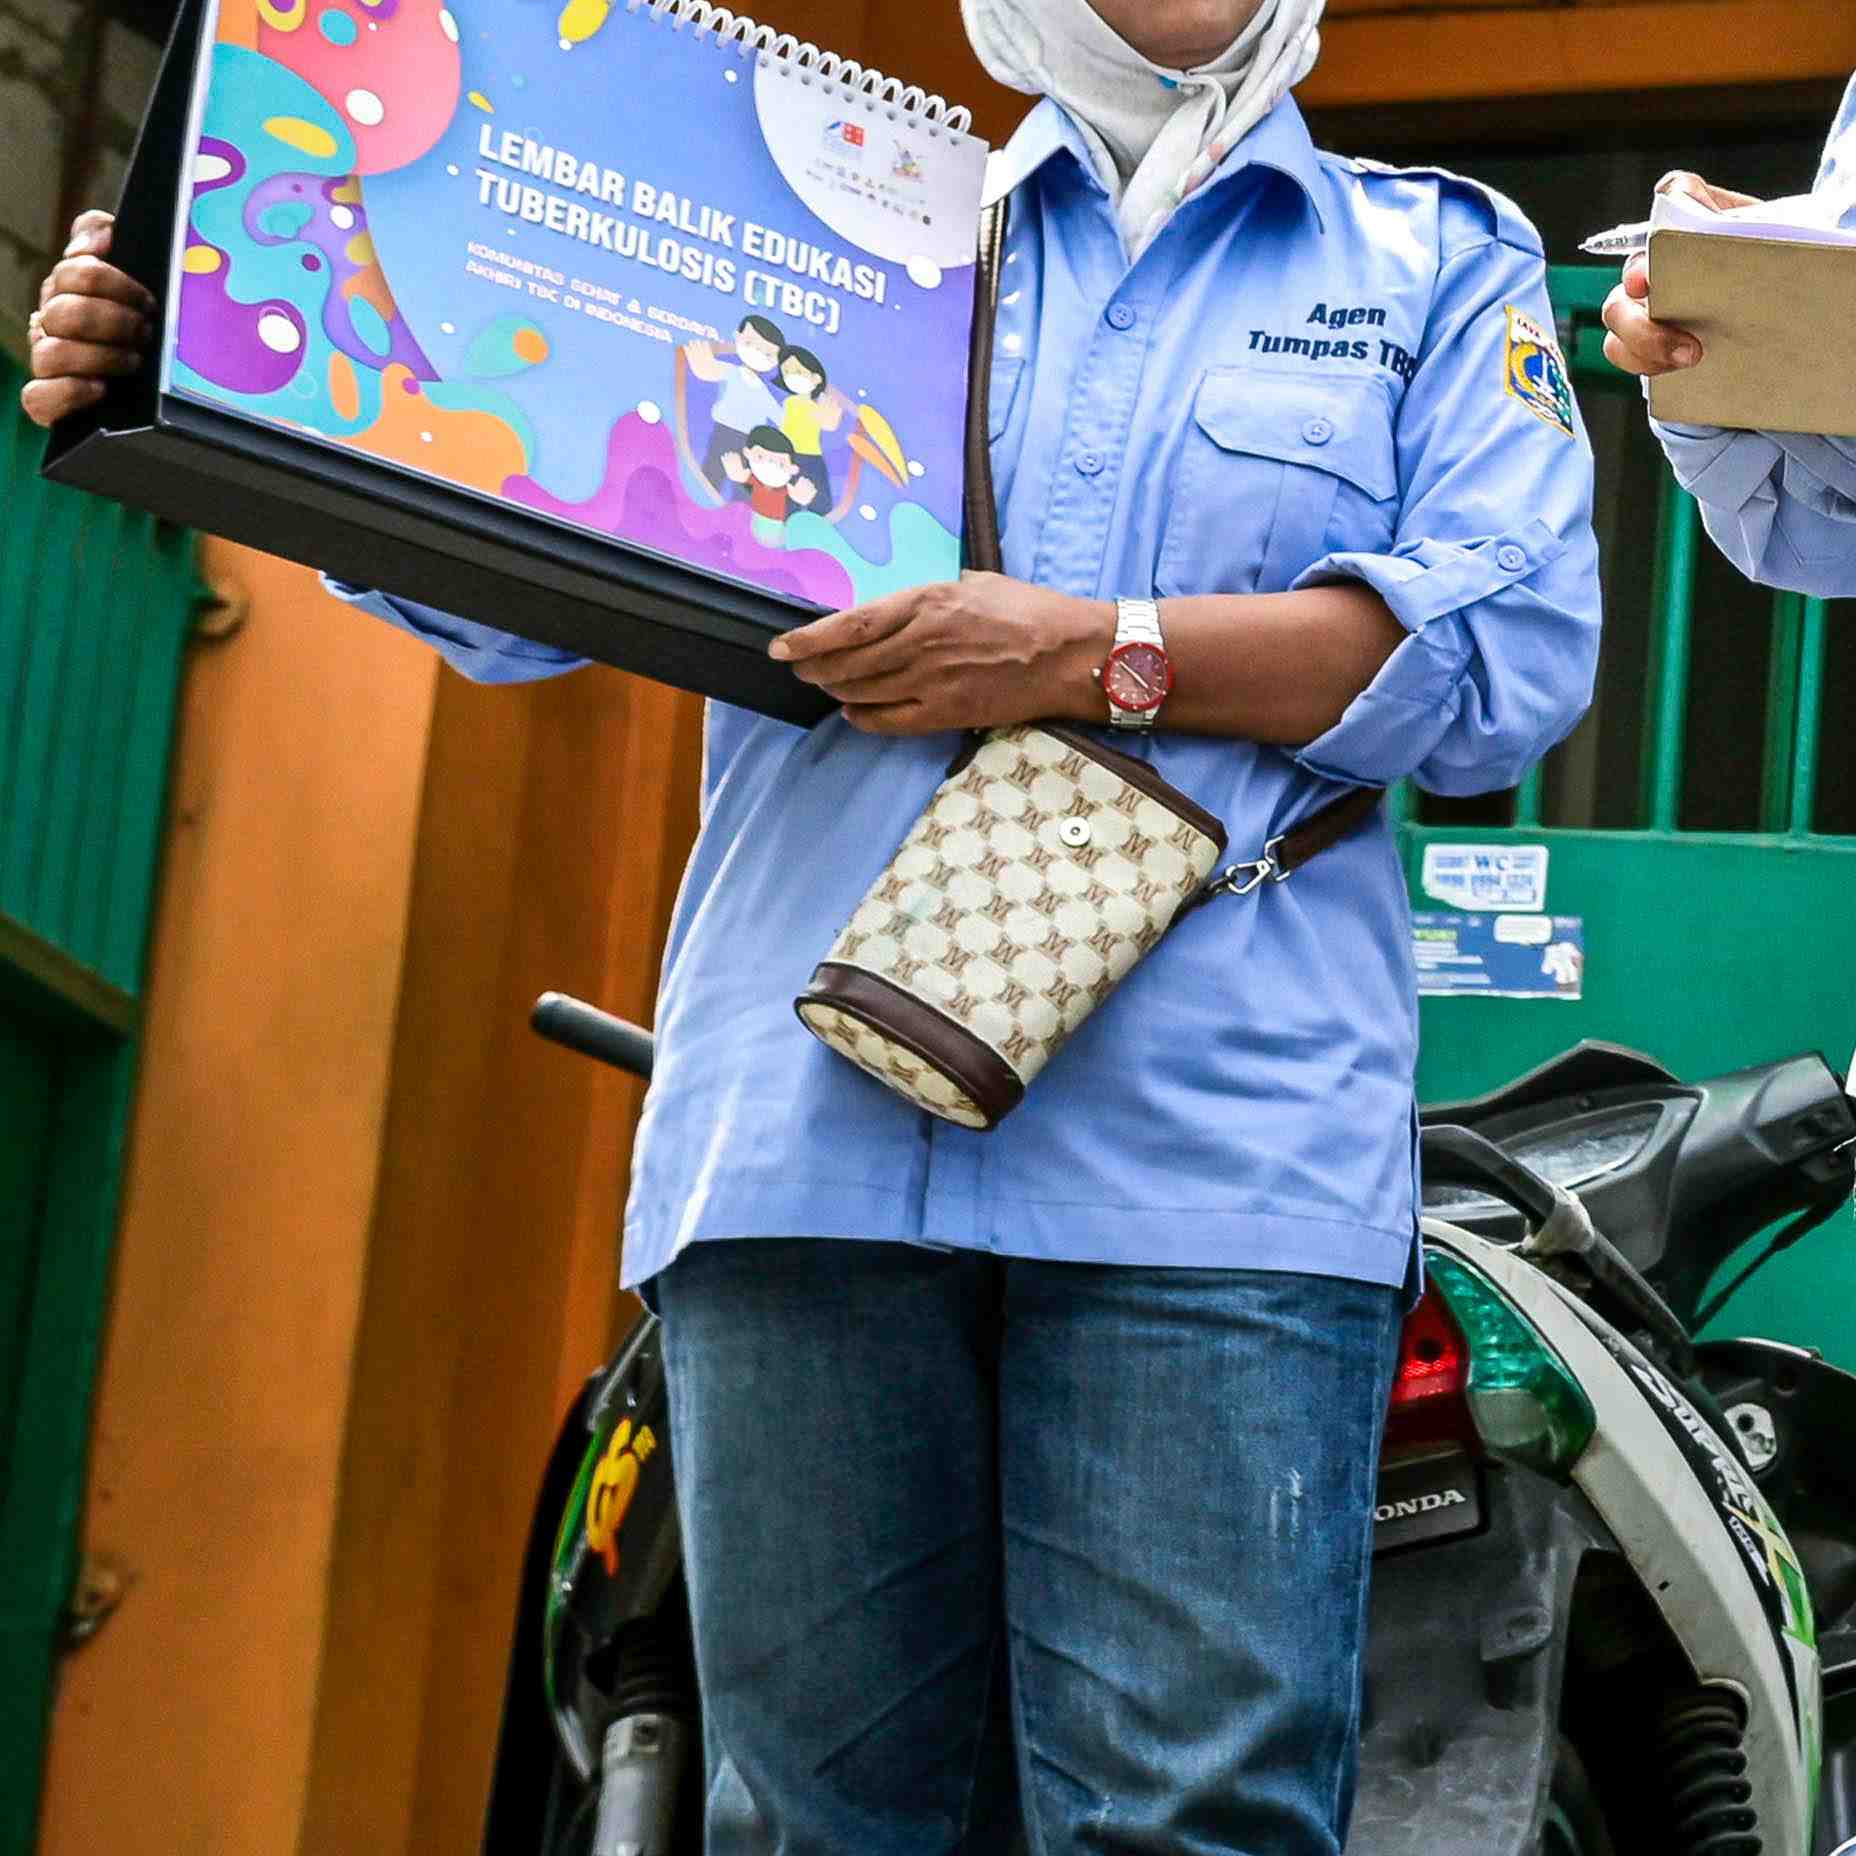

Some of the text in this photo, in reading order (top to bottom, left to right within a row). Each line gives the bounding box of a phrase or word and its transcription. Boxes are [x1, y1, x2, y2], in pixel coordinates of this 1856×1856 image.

[479, 122, 626, 207] LEMBAR
[631, 180, 736, 248] BALIK
[741, 222, 888, 304] EDUKASI
[475, 167, 737, 293] TUBERKULOSIS
[1306, 302, 1387, 330] Agen
[1248, 330, 1369, 361] Tumpas
[1375, 1489, 1467, 1521] ONDA
